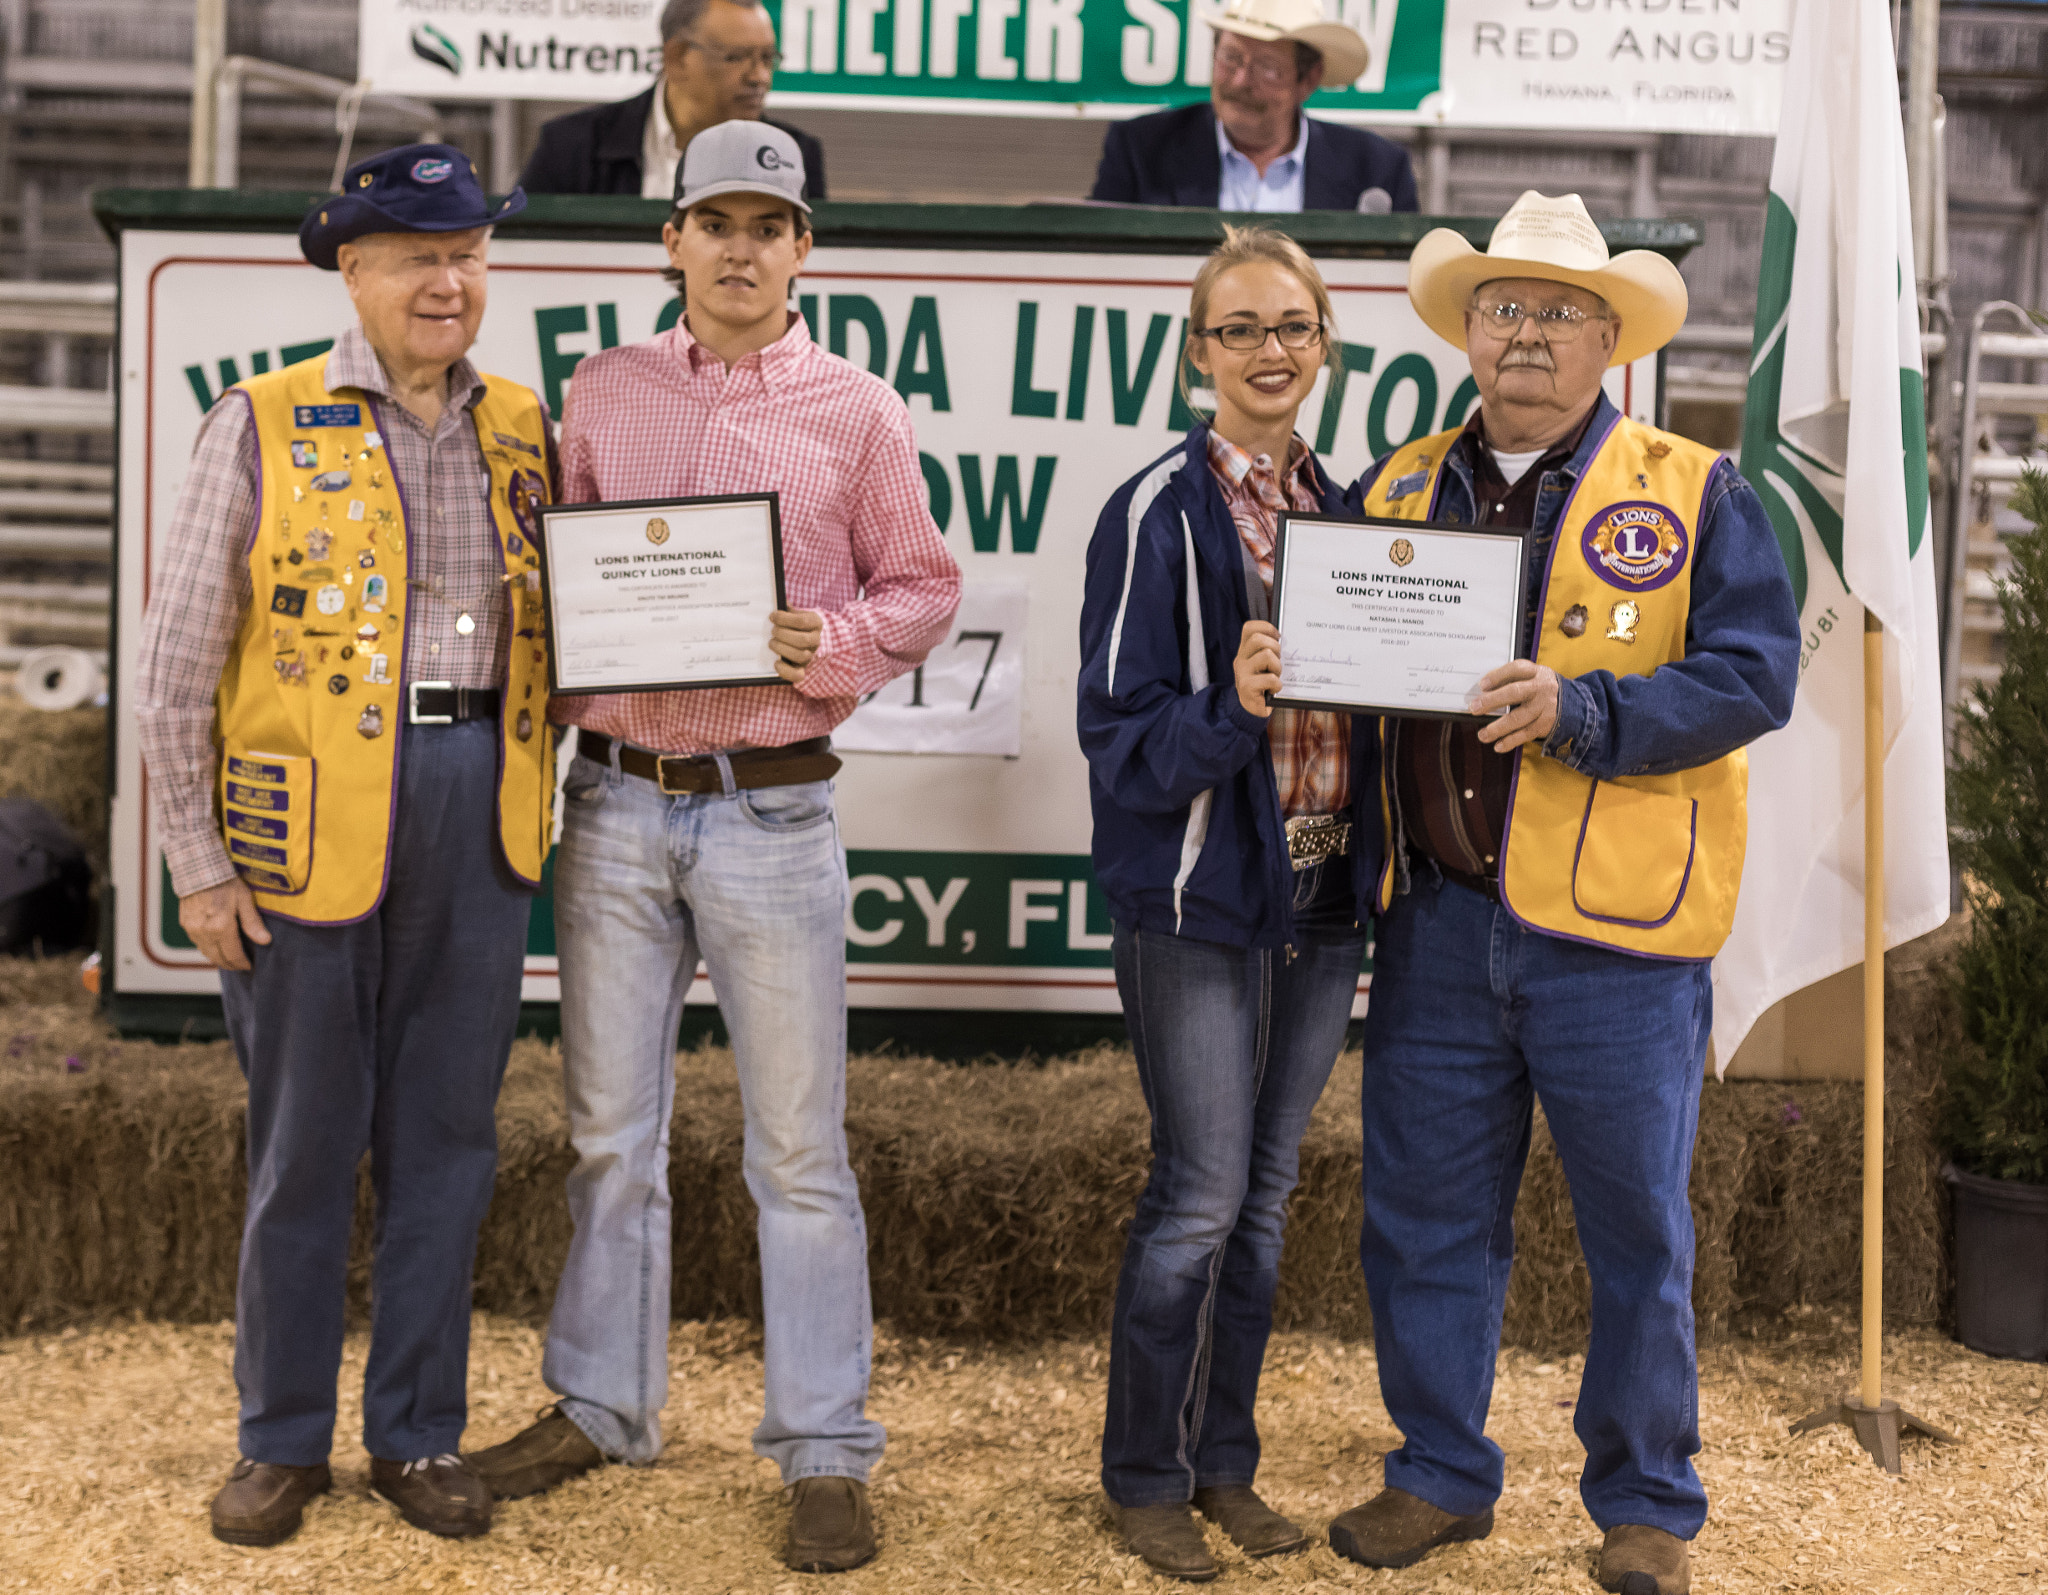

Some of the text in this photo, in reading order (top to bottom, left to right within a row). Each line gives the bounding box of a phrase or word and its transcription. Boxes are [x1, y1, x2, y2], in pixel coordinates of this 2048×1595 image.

[1472, 21, 1790, 64] RED ANGUS
[1612, 510, 1660, 526] LIONS
[1623, 527, 1649, 558] L
[595, 550, 726, 565] LIONS INTERNATIONAL
[602, 565, 721, 580] QUINCY LIONS CLUB
[1332, 571, 1468, 589] LIONS INTERNATIONAL
[1336, 586, 1461, 604] QUINCY LIONS CLUB
